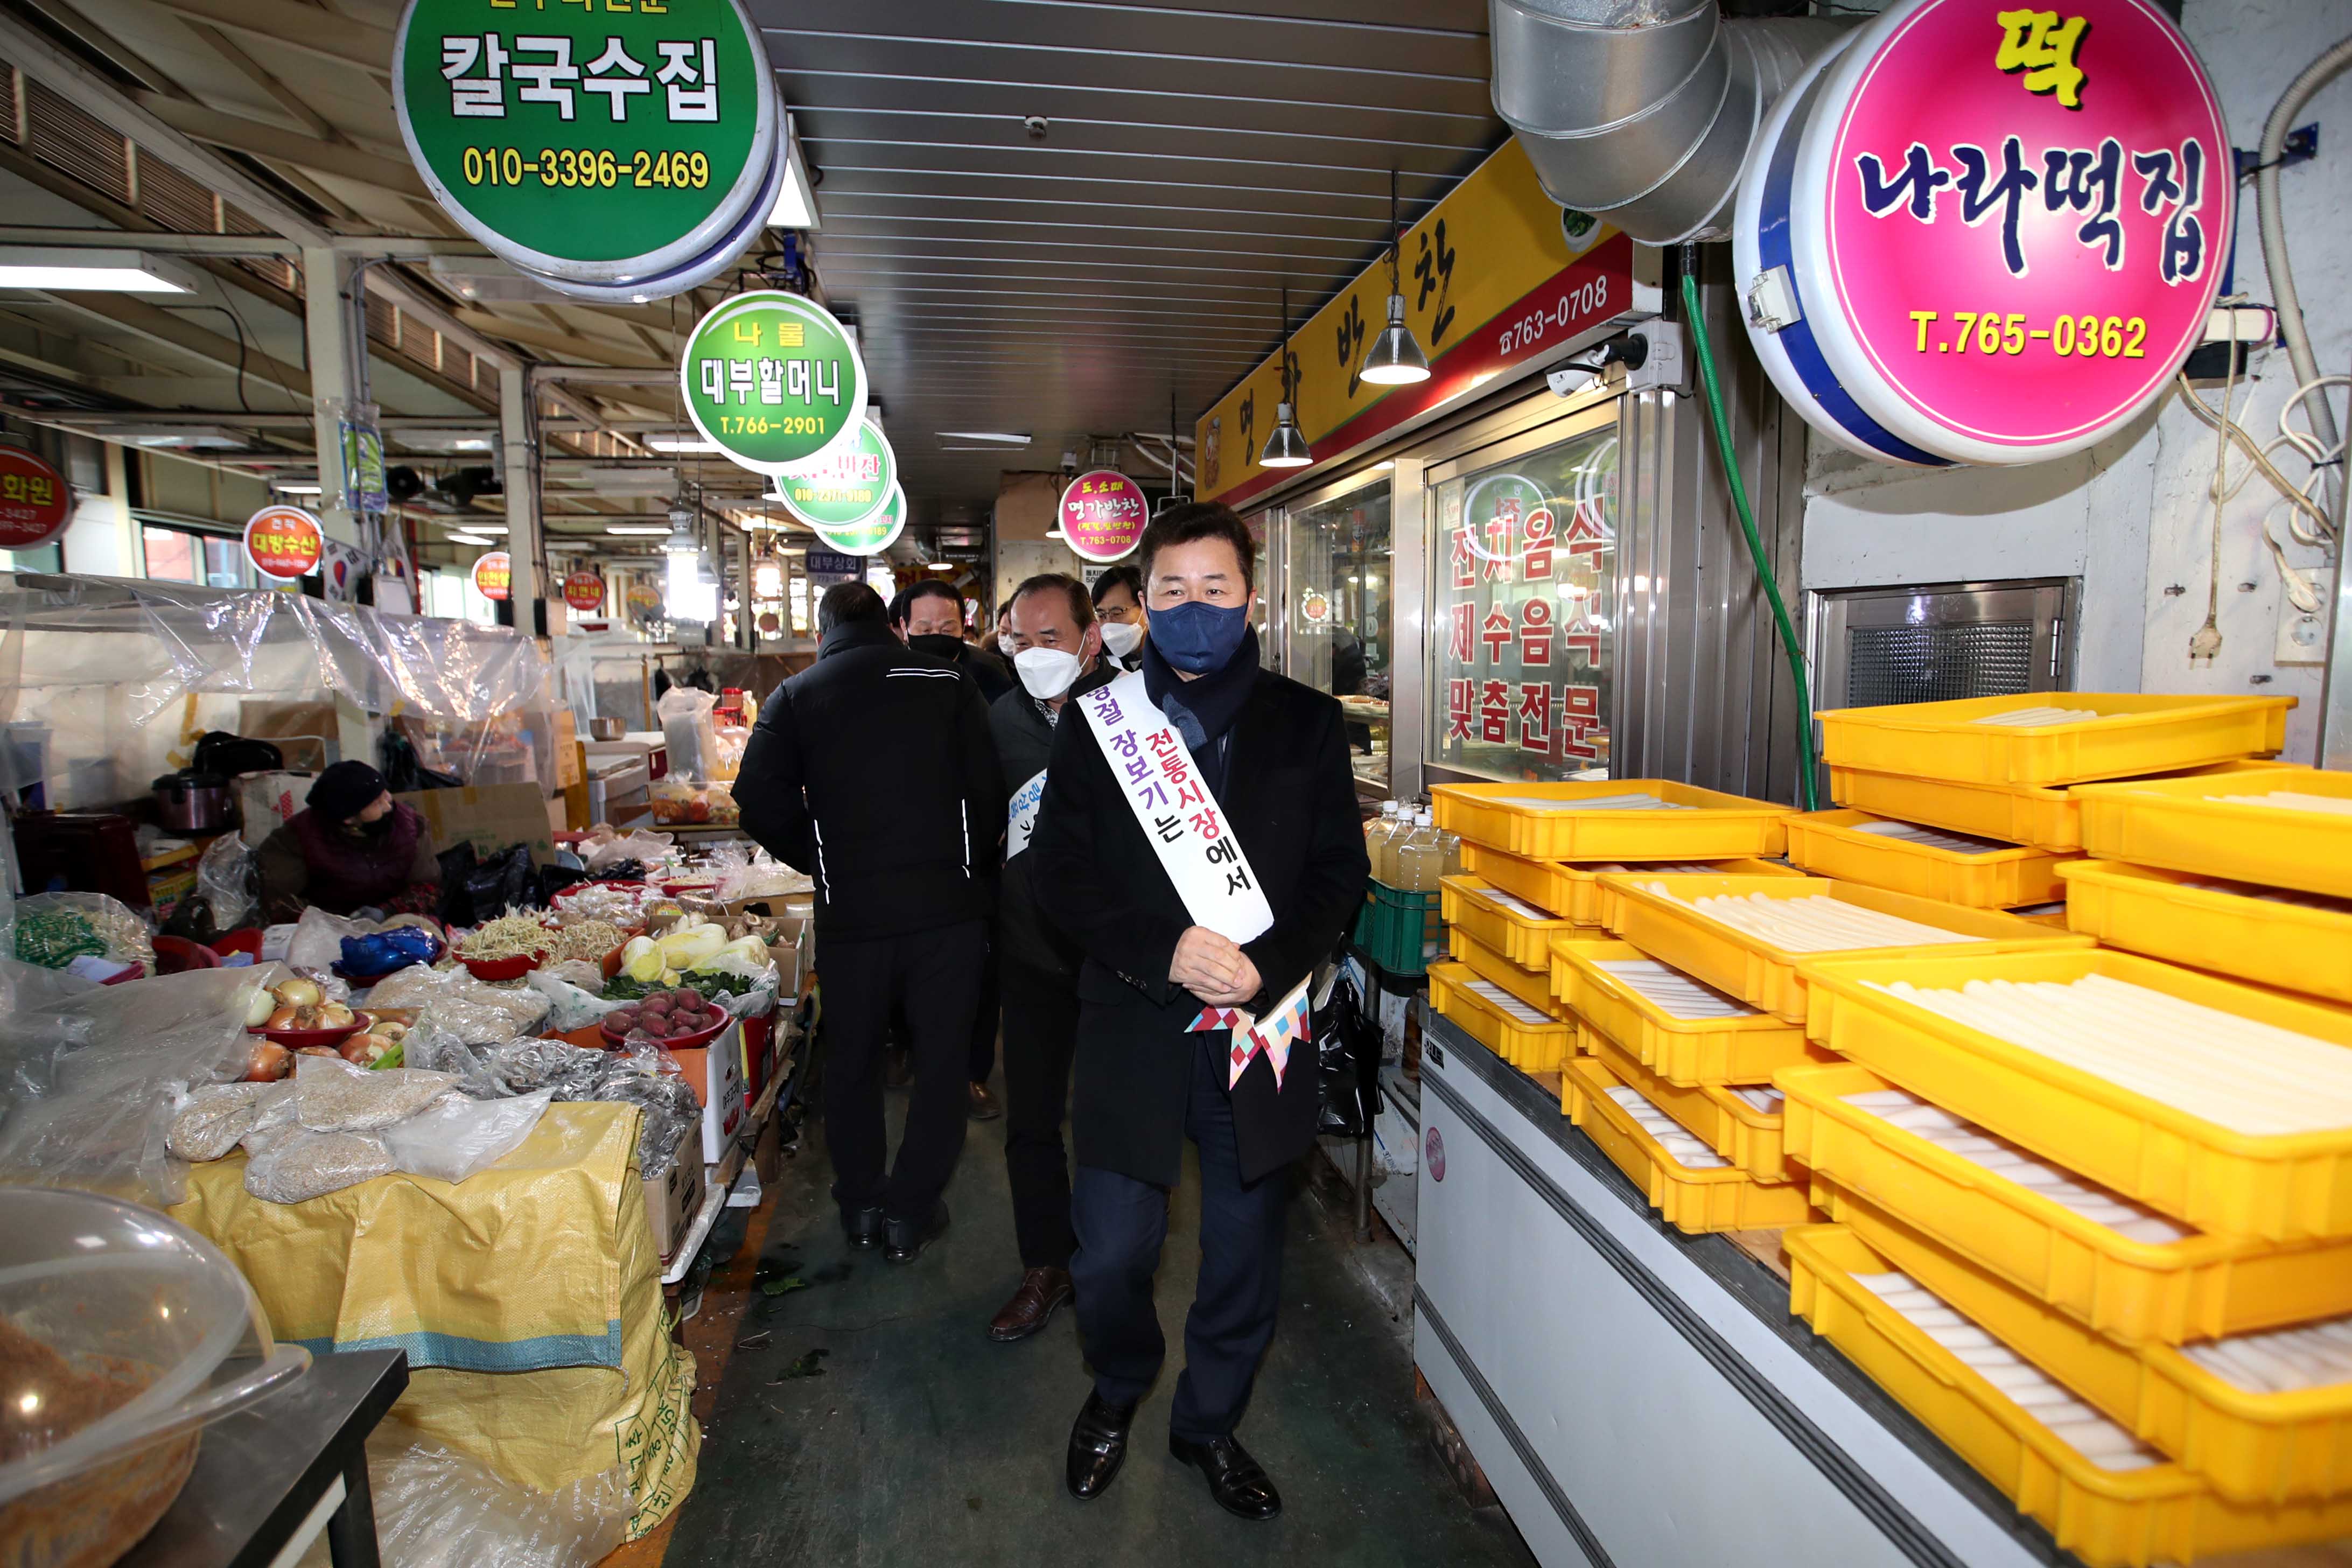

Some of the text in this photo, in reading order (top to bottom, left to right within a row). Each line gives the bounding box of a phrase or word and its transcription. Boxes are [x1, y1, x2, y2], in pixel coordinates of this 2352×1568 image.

[439, 31, 720, 123] 칼국수집
[1995, 9, 2091, 110] 떡
[463, 146, 710, 190] 010-3396-2469
[1857, 134, 2207, 285] 나라떡집
[1910, 311, 2147, 359] T.765-0362
[700, 357, 840, 405] 대부할머니
[720, 417, 825, 435] T.766-2901
[1068, 498, 1140, 520] 명가반찬
[1080, 536, 1131, 545] T.763-0708
[810, 555, 856, 570] 대부상회
[1450, 493, 1606, 590] 잔치음식
[1448, 589, 1602, 668] 제수음식
[1448, 677, 1600, 762] 맞춤전문
[1145, 728, 1251, 896] 전통시장에서
